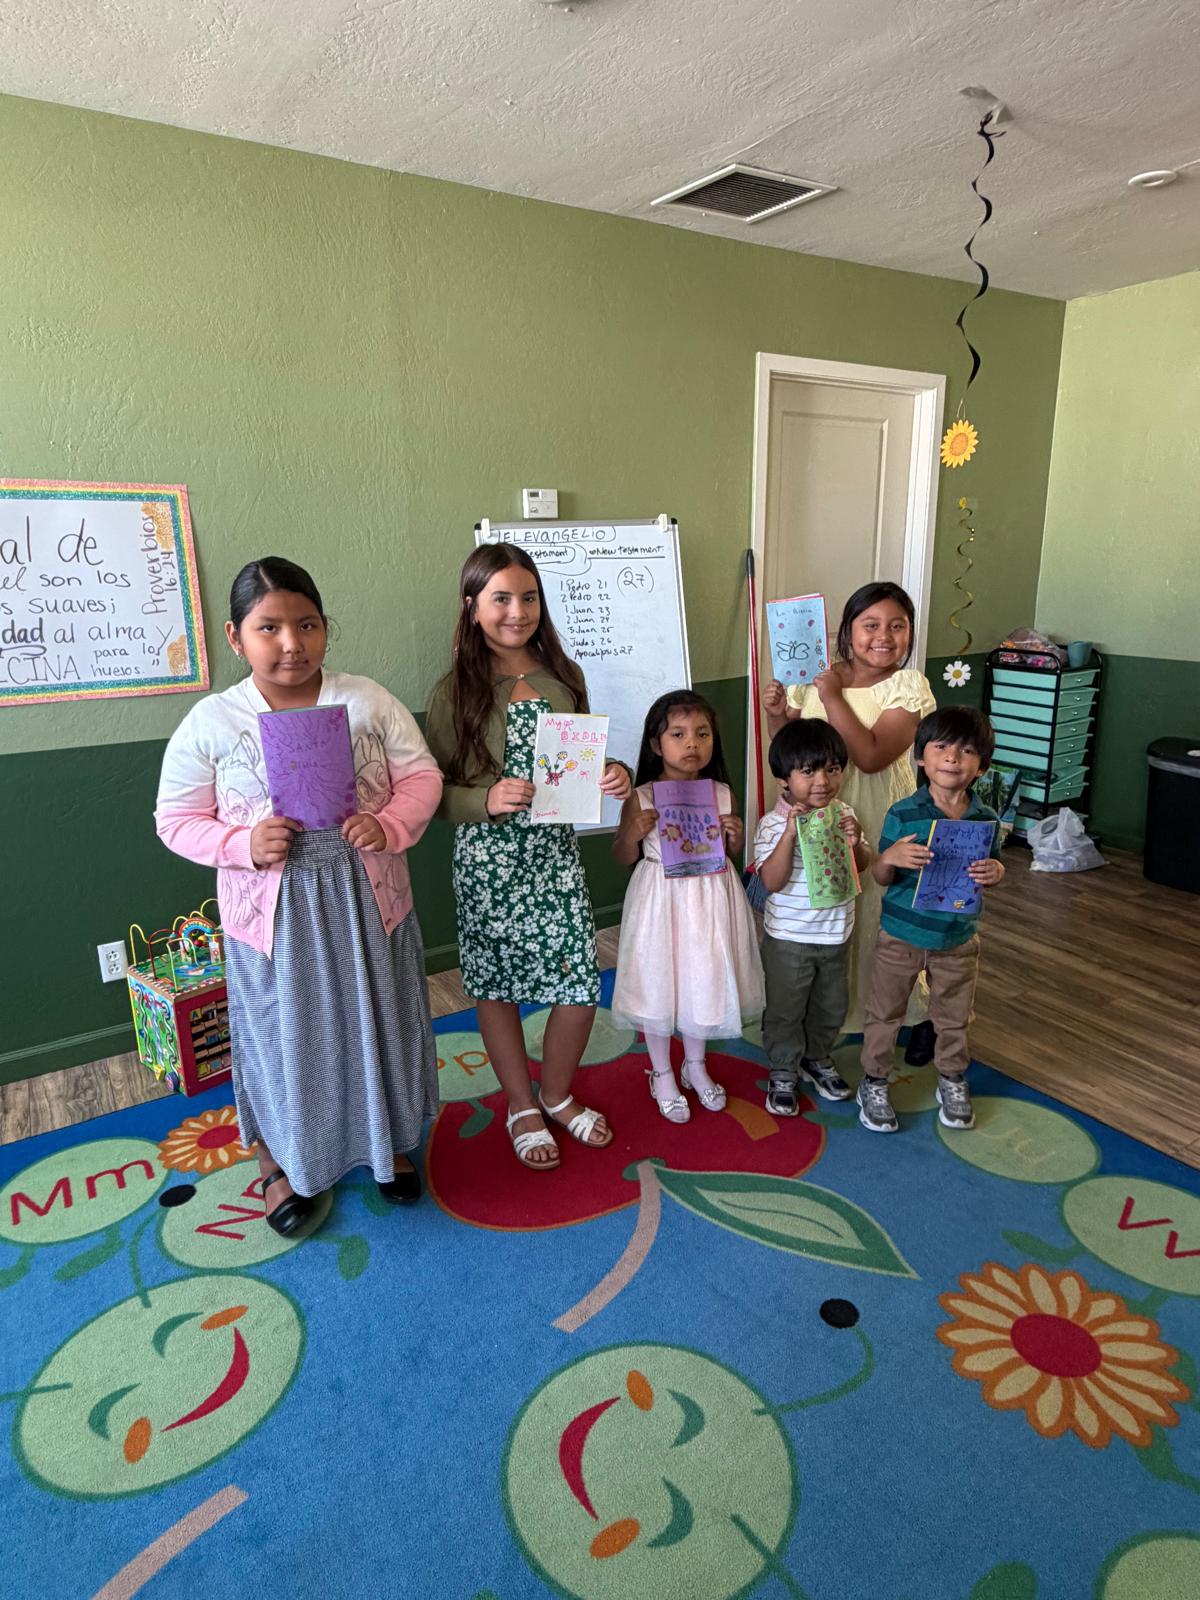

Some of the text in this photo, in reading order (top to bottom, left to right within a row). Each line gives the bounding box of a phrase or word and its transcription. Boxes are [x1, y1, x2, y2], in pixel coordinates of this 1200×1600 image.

[58, 517, 104, 566] de
[39, 573, 82, 588] son
[97, 570, 131, 588] los
[566, 578, 591, 592] Pedro
[597, 578, 607, 590] 21
[560, 593, 568, 603] 2
[570, 590, 592, 601] Pedro
[28, 598, 116, 614] suaves;
[570, 604, 595, 614] Juan
[597, 606, 611, 616] 23
[573, 615, 596, 624] Juan
[53, 622, 76, 644] al
[88, 621, 147, 641] alma
[576, 625, 598, 634] Juan
[569, 637, 596, 648] Judas
[93, 647, 130, 665] para
[10, 1159, 155, 1226] Mm
